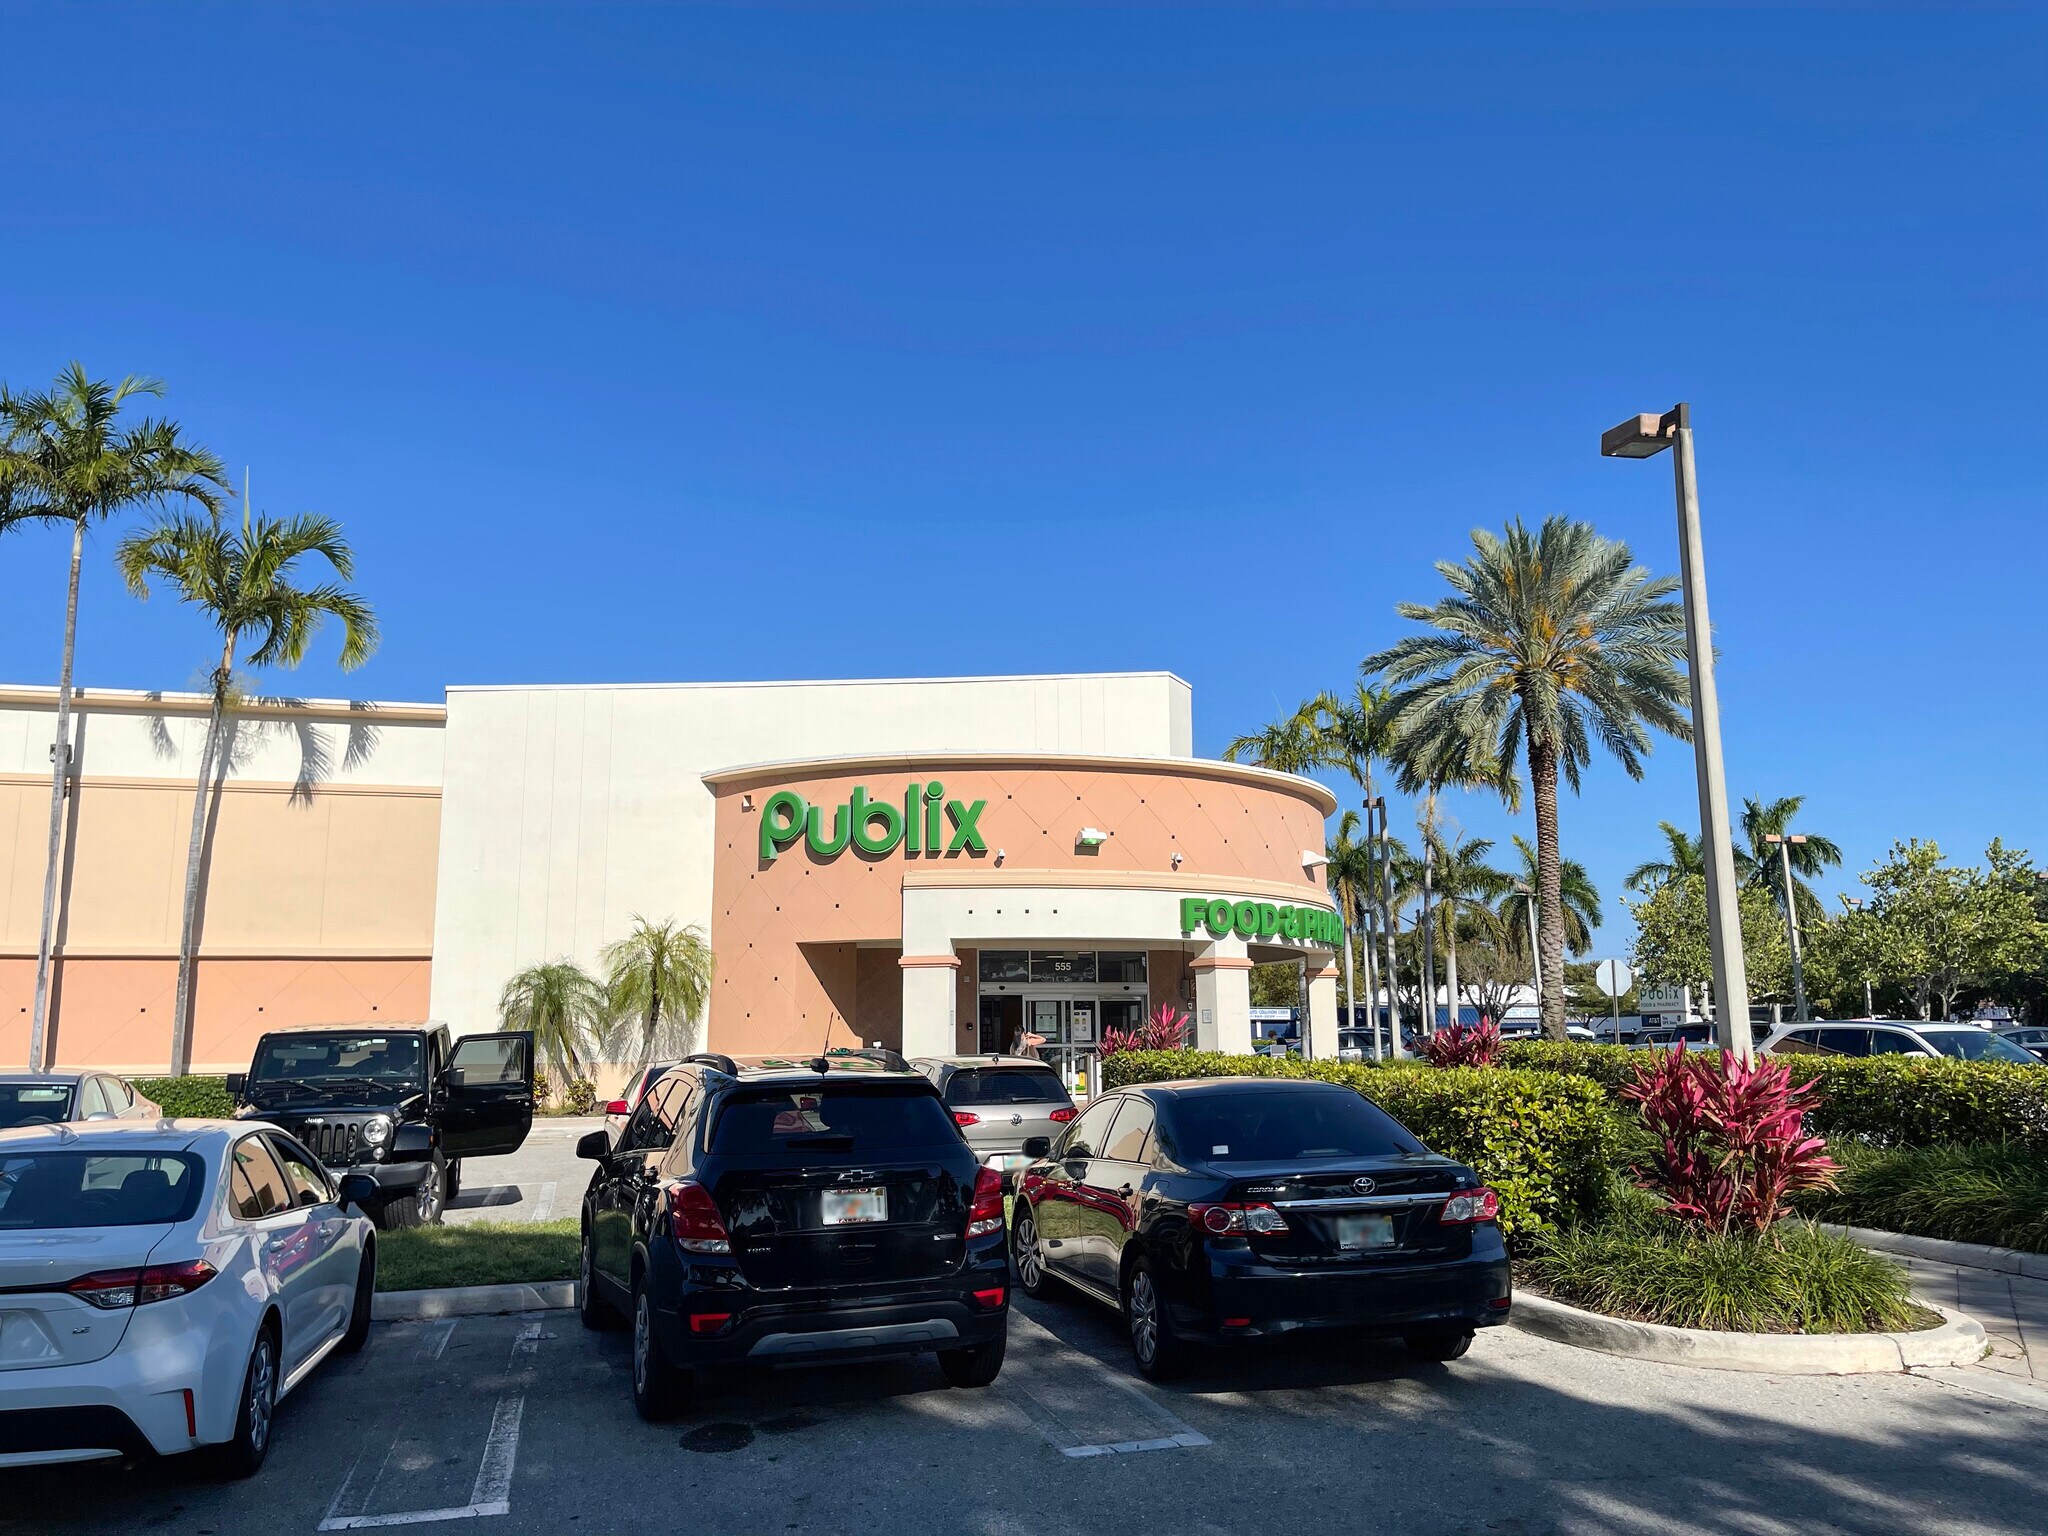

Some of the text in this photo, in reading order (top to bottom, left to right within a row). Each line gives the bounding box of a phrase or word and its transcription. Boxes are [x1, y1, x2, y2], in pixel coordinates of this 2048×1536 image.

[761, 780, 988, 860] Publix
[1180, 898, 1280, 937] FOOD
[1279, 904, 1300, 939] &
[1055, 962, 1072, 971] 555
